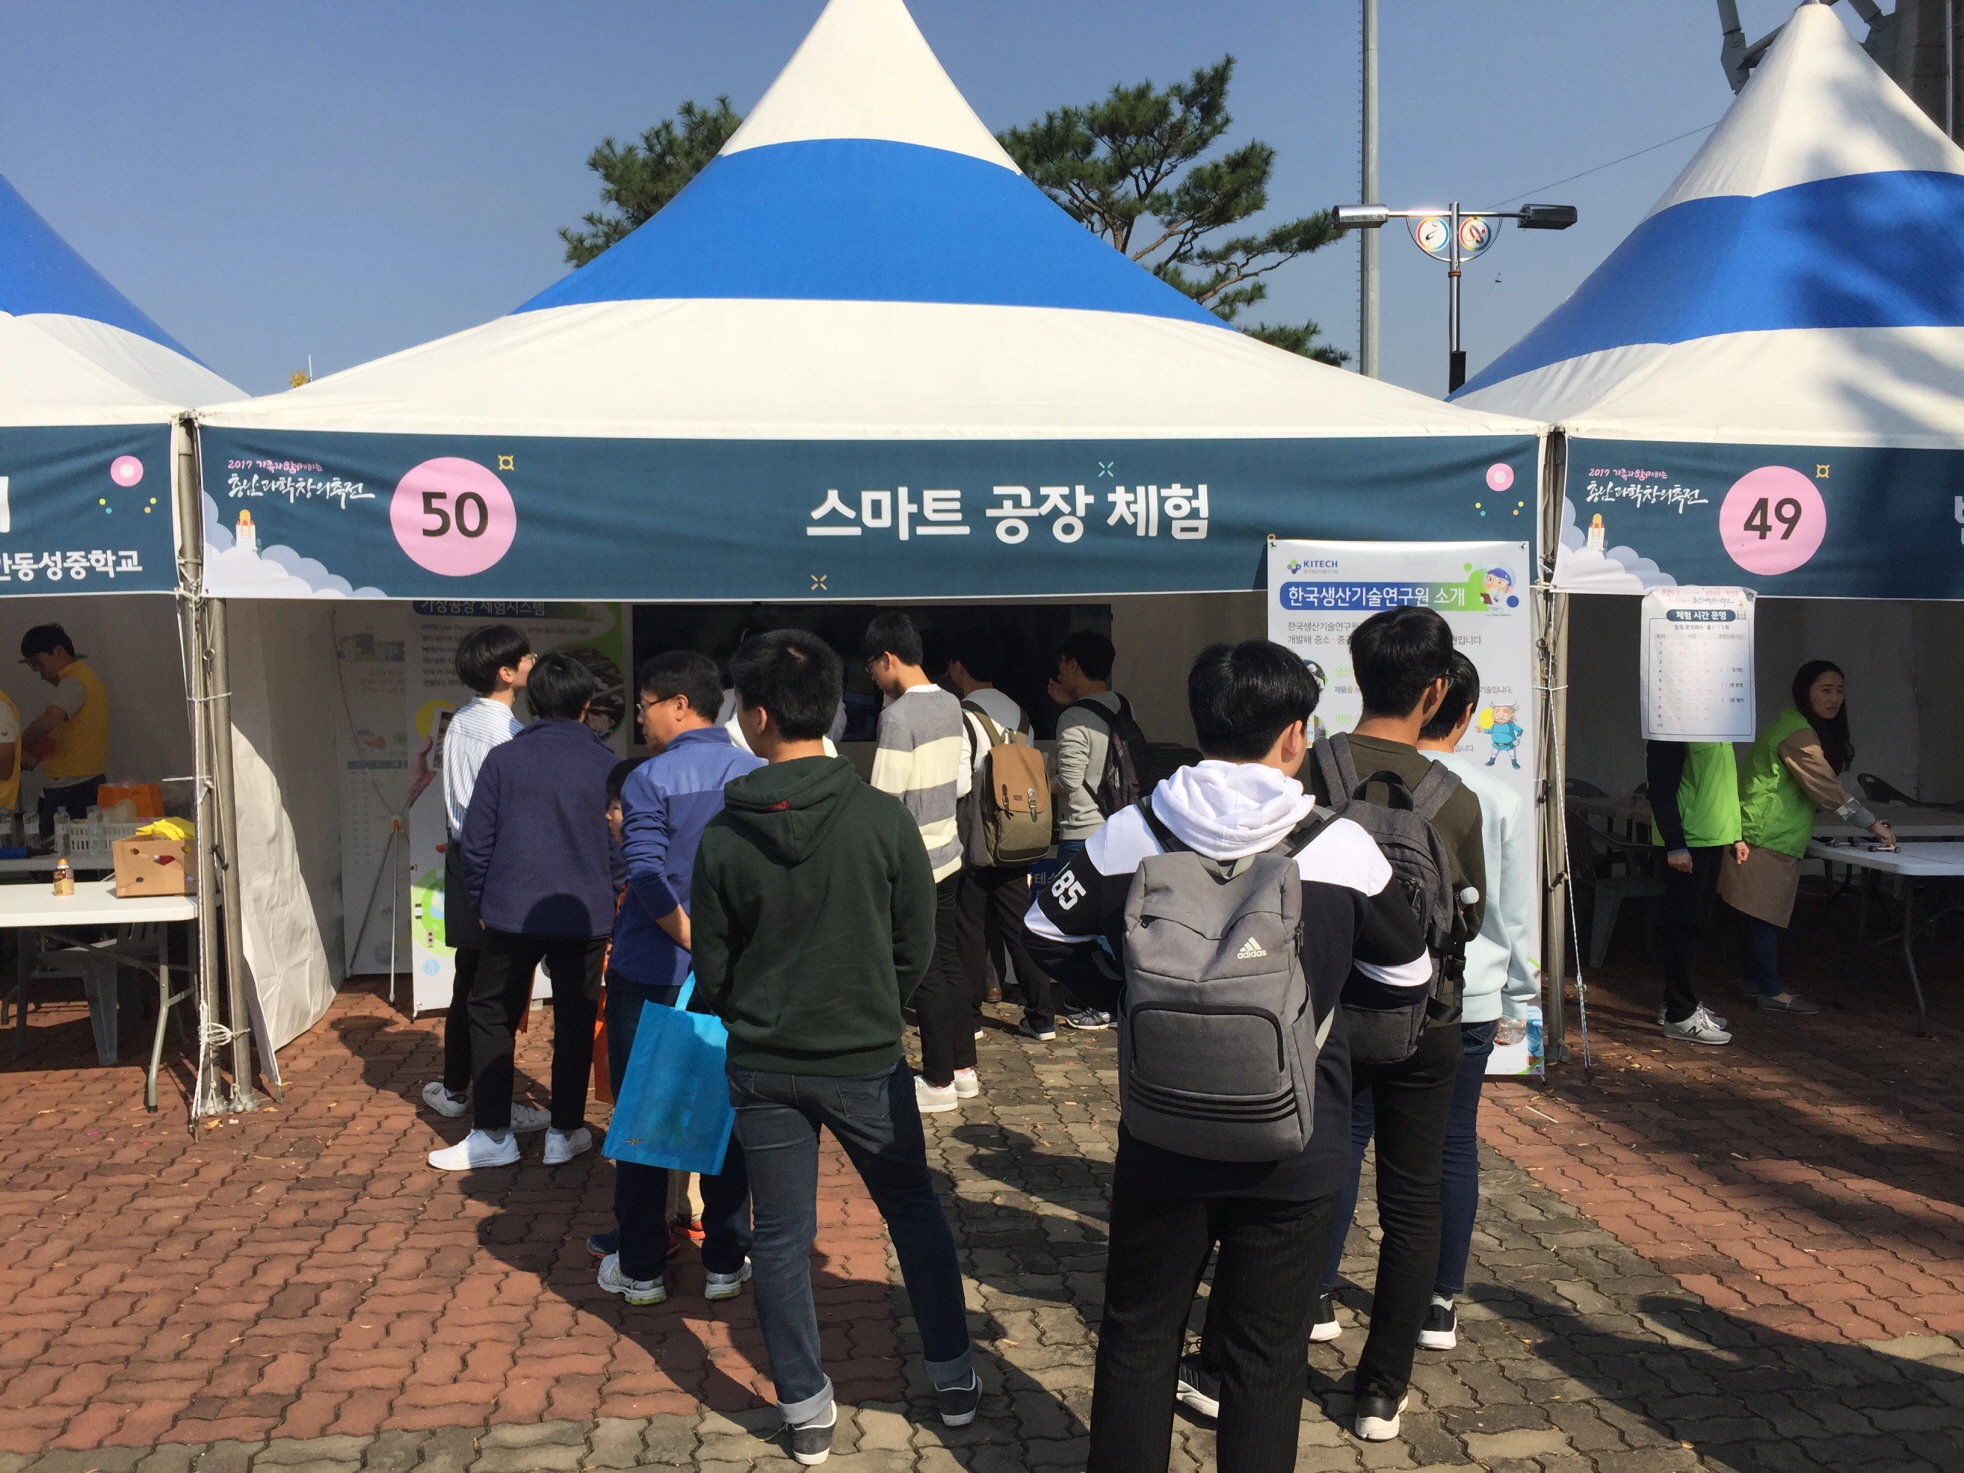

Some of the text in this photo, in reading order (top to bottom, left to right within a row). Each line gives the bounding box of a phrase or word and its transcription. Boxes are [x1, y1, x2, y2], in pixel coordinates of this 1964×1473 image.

[228, 460, 253, 469] 2017
[1588, 468, 1610, 477] 2017
[227, 472, 376, 510] 충남과학창의축전
[1586, 480, 1709, 515] 충남과학창의축전
[420, 491, 490, 539] 50
[806, 483, 1209, 545] 스마트 공장 체험
[1743, 497, 1802, 541] 49
[1303, 560, 1338, 568] KITECH
[1288, 586, 1465, 607] 한국생산기술연구원 소개
[1676, 611, 1727, 620] 체험 시간 운영
[1287, 634, 1349, 645] 개발해 중소 중
[1334, 714, 1352, 725] 어떤
[1051, 869, 1087, 911] 85
[1237, 950, 1268, 960] adidas
